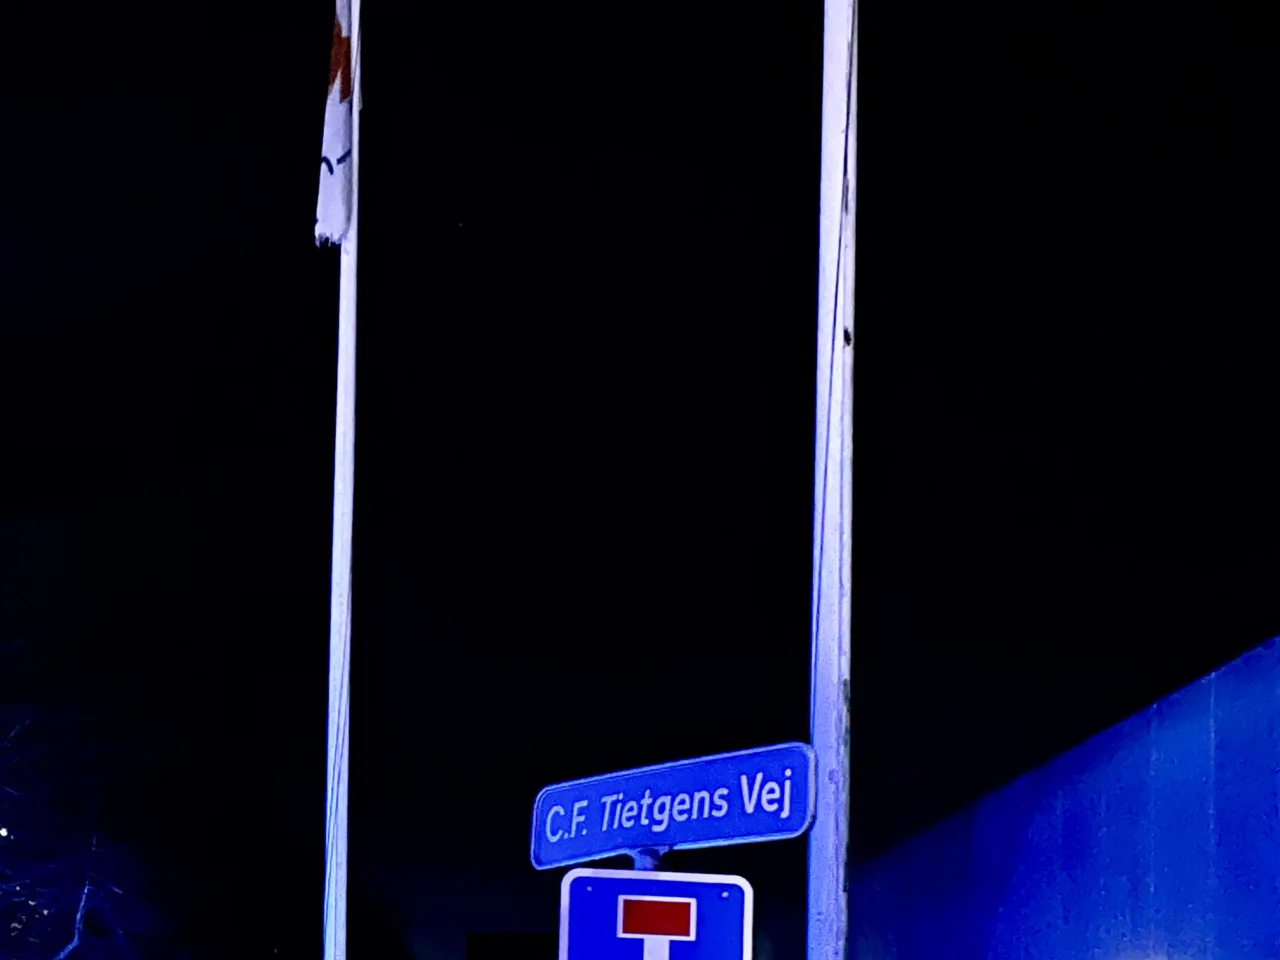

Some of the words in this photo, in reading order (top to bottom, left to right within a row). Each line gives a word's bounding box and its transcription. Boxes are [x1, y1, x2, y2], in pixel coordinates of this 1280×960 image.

[546, 800, 588, 843] C.F.
[601, 788, 729, 832] Tietgens
[741, 768, 792, 819] Vej
